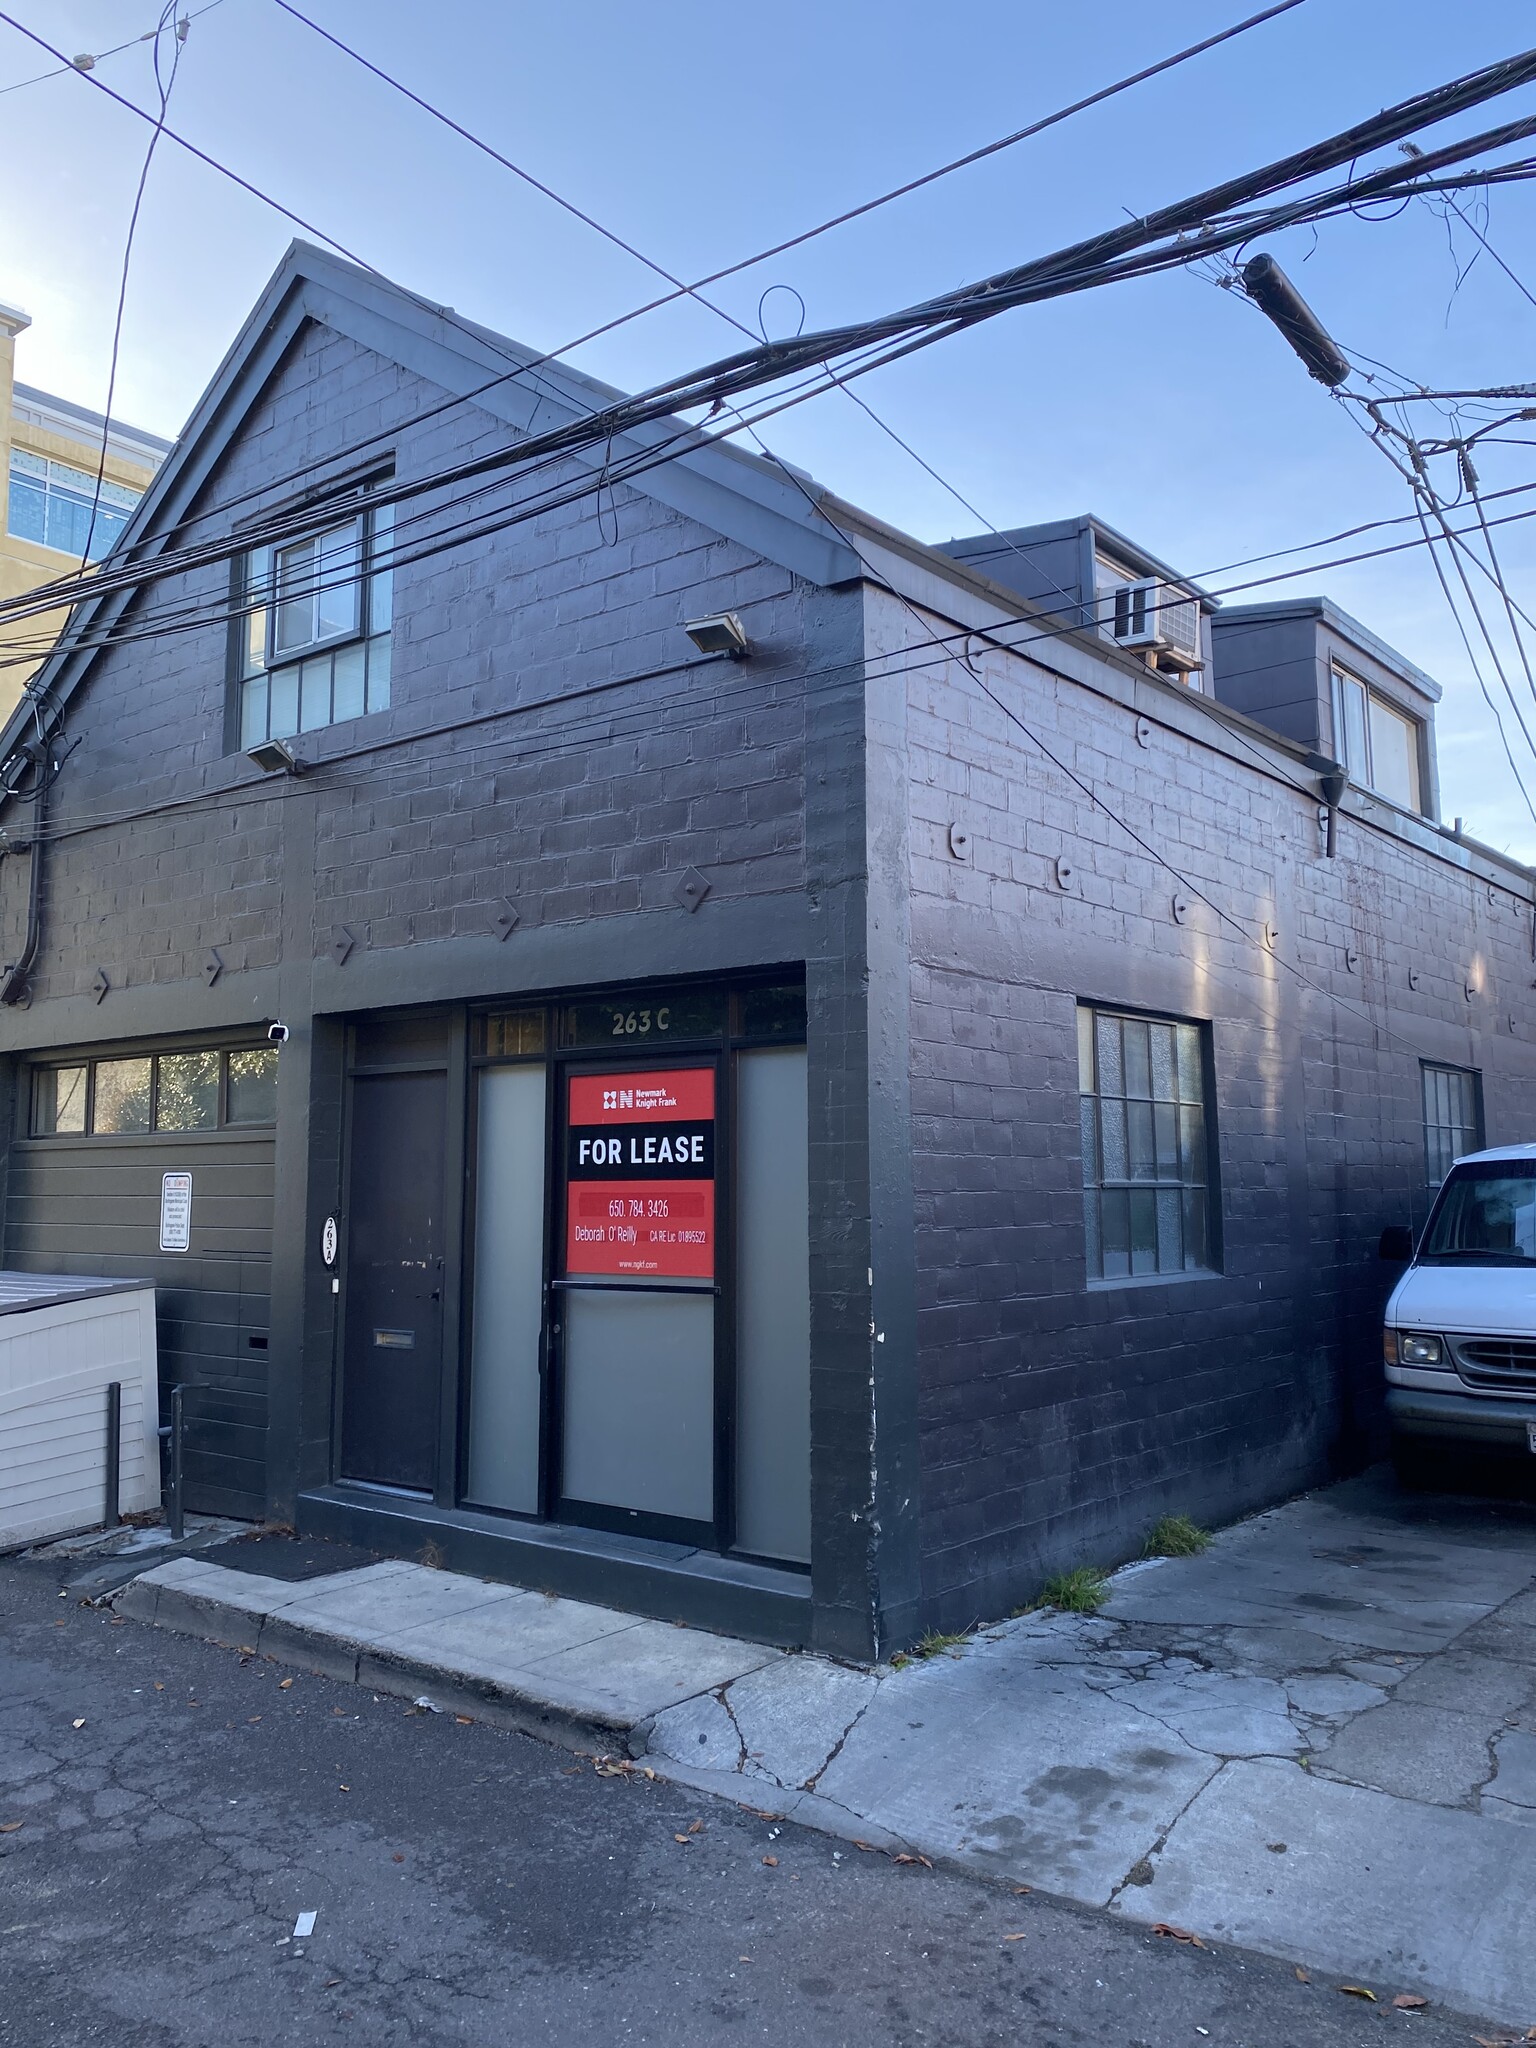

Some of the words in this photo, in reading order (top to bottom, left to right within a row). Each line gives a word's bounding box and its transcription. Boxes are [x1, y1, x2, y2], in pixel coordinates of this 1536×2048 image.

[612, 1010, 651, 1035] 263
[657, 1008, 670, 1030] C
[635, 1088, 667, 1098] Newmark
[635, 1098, 657, 1109] Knight
[658, 1097, 677, 1107] Frank
[579, 1139, 622, 1165] FOR
[630, 1135, 704, 1164] LEASE
[608, 1199, 626, 1218] 650.
[628, 1199, 646, 1218] 784.
[647, 1199, 669, 1218] 3426
[575, 1225, 605, 1241] Deborah
[617, 1225, 638, 1246] Reilly
[649, 1230, 658, 1242] CA
[658, 1230, 667, 1243] RE
[618, 1260, 658, 1271] www.ngkf.com
